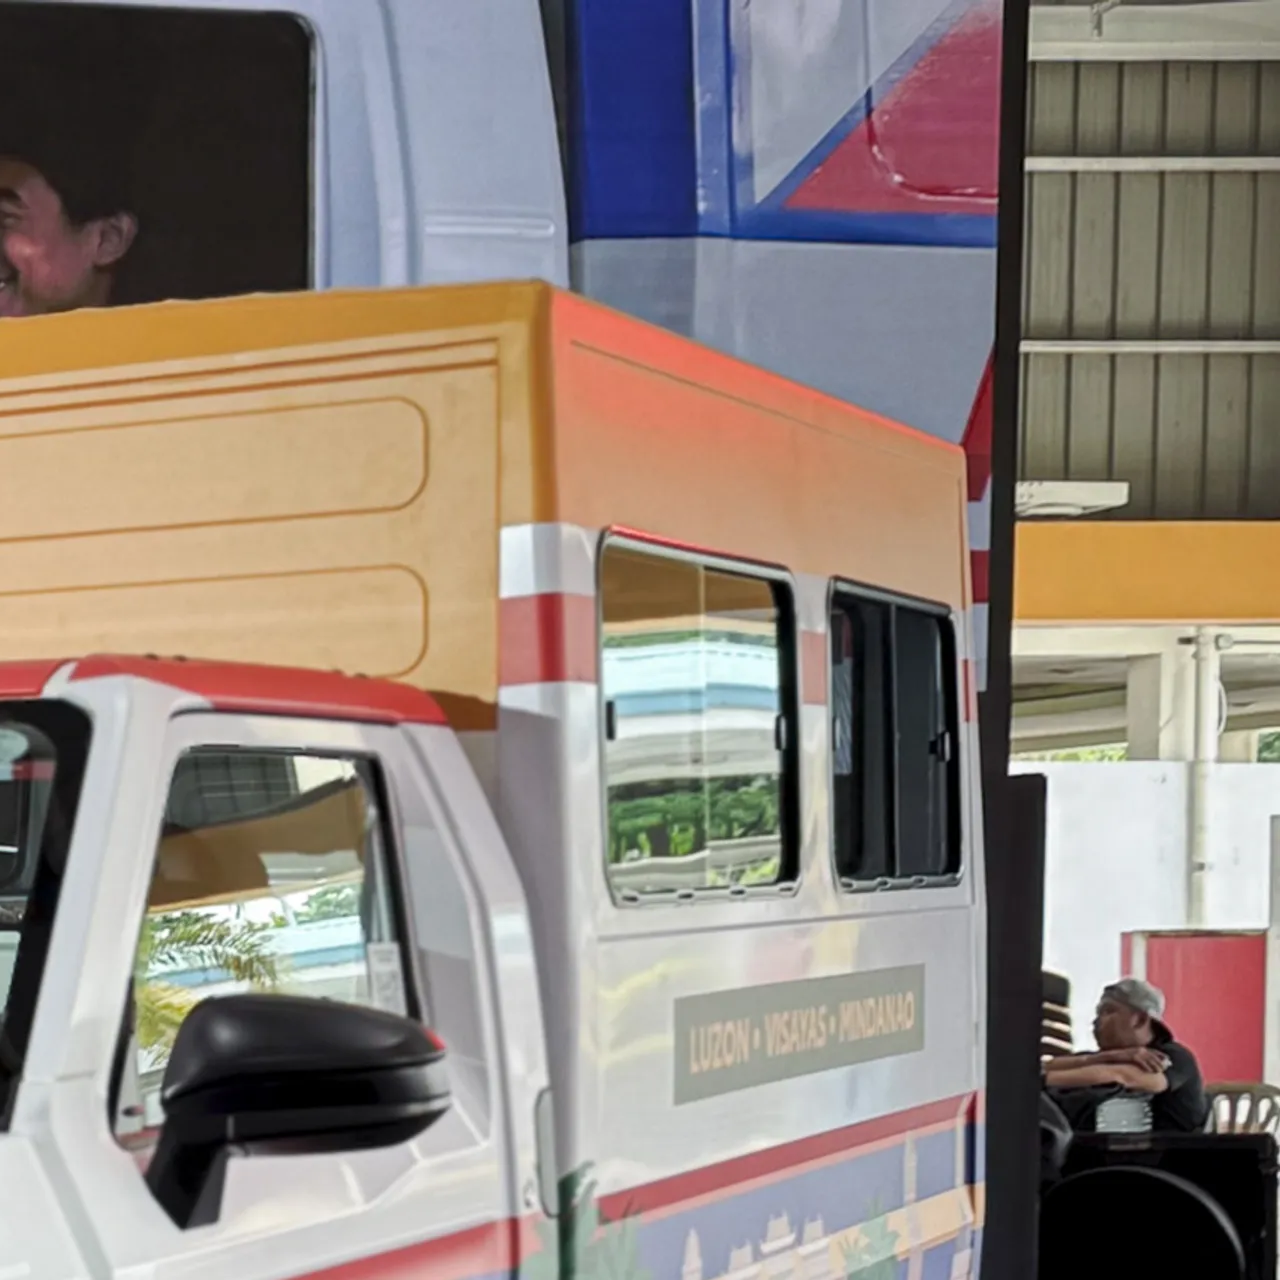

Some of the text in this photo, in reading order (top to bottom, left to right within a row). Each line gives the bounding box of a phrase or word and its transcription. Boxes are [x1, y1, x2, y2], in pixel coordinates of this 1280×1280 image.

[690, 991, 916, 1075] LUZON VISAYAS MINDANAO
